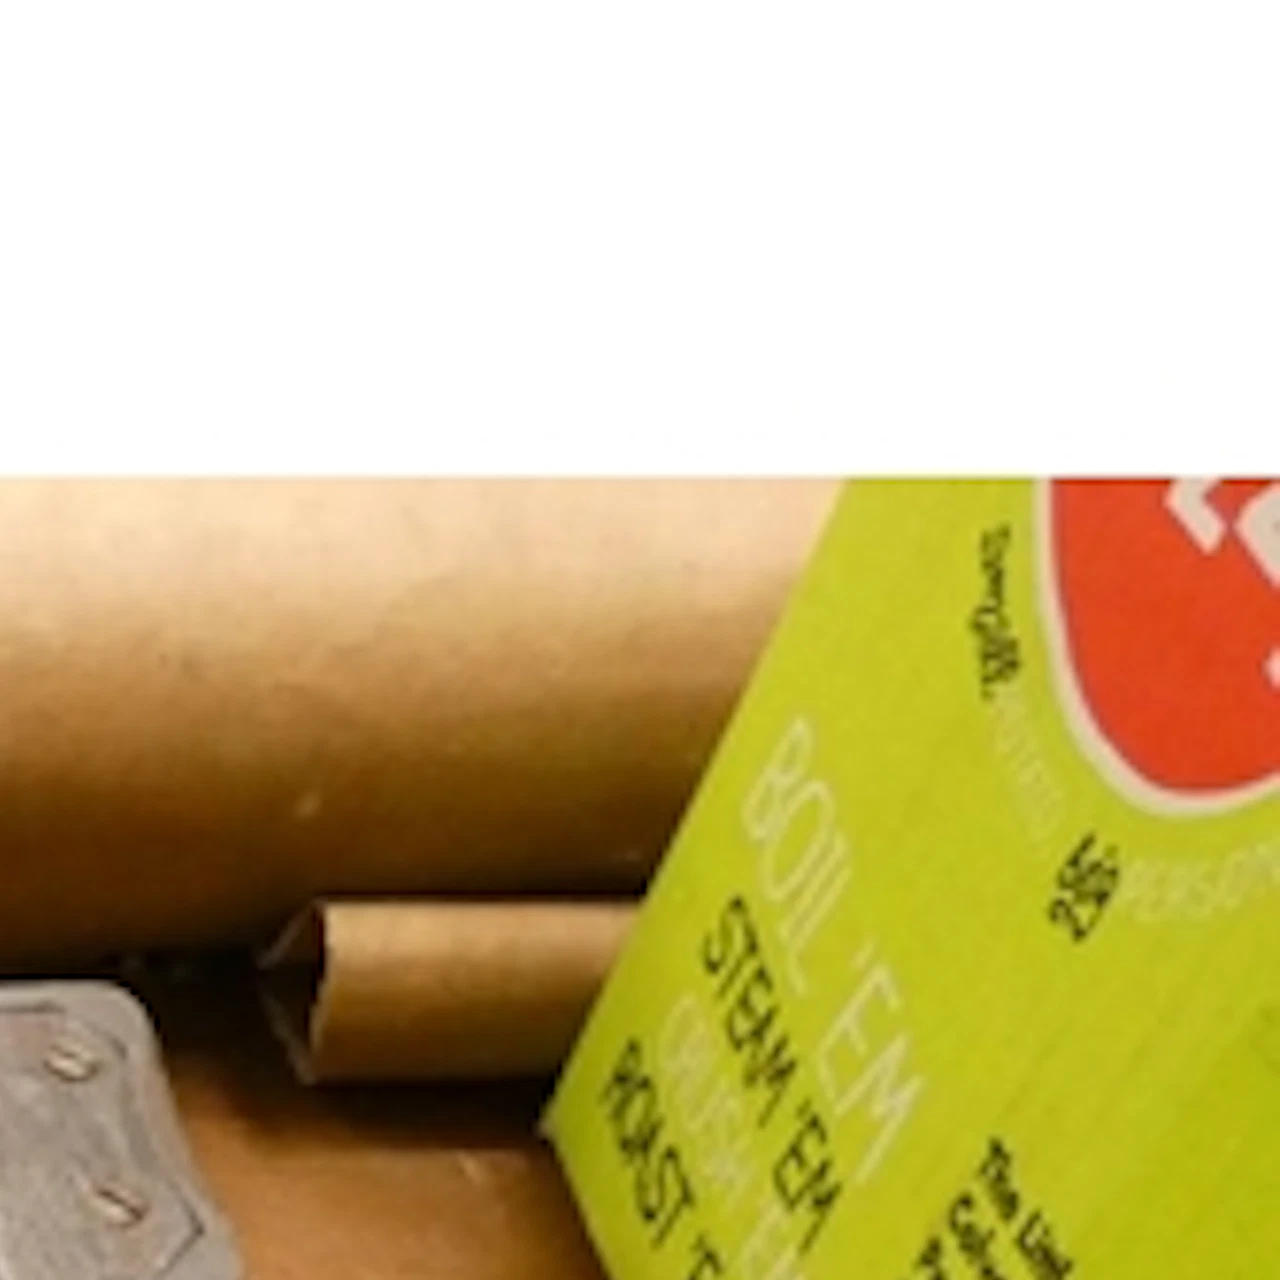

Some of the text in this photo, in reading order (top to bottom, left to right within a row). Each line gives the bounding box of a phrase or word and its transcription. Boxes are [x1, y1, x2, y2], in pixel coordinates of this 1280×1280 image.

[739, 712, 855, 1002] BOIL
[703, 896, 799, 1128] STEAM
[602, 1039, 695, 1244] ROAST
[979, 1139, 1021, 1223] The
